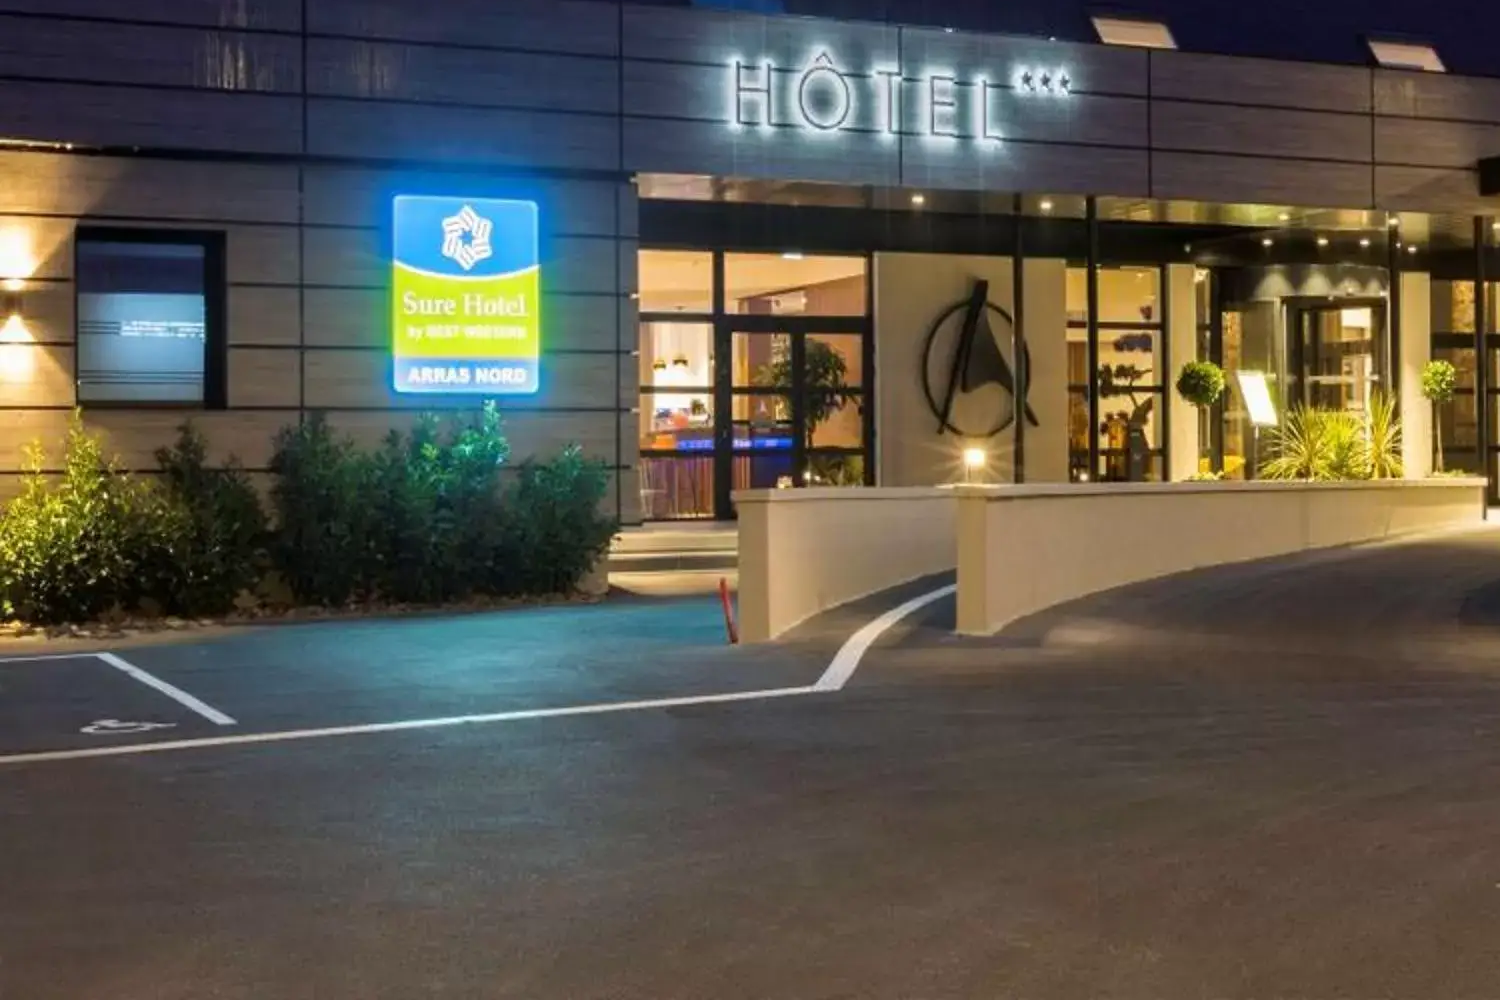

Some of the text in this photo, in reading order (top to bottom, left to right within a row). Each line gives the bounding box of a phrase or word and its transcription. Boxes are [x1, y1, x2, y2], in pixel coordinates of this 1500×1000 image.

[732, 50, 1003, 143] HÔTEL
[403, 291, 528, 317] Sure Hotel
[408, 366, 527, 384] ARRAS NORD
